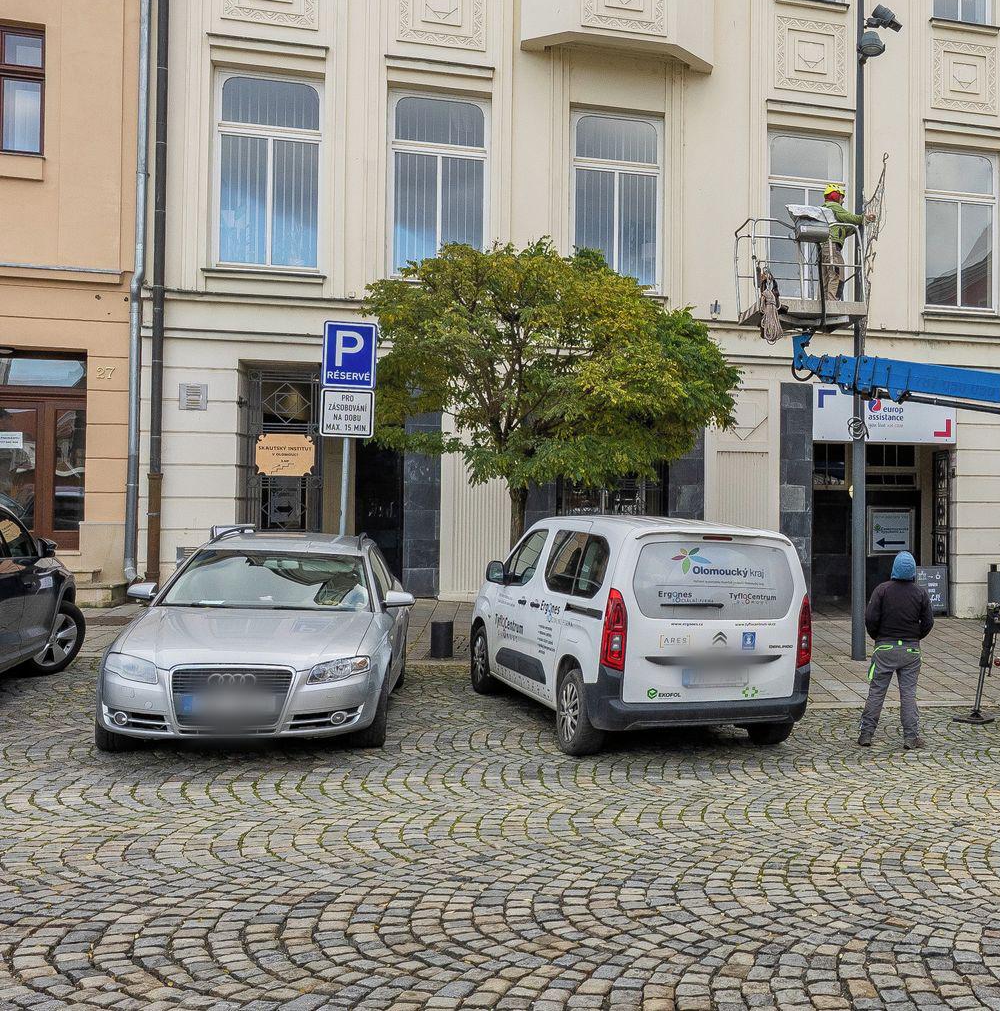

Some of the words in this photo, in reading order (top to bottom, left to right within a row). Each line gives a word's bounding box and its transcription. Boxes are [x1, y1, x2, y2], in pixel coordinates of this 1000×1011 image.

[335, 330, 364, 367] P
[96, 367, 116, 380] 27
[327, 370, 370, 381] RÉSERVÉ
[341, 394, 354, 402] PRO
[328, 403, 367, 412] ZÁSOBOVÁNÍ
[333, 413, 342, 421] NA
[344, 414, 361, 422] DOBU
[326, 423, 341, 431] MAX.
[693, 565, 748, 577] Olomoucký
[750, 569, 765, 579] kraj
